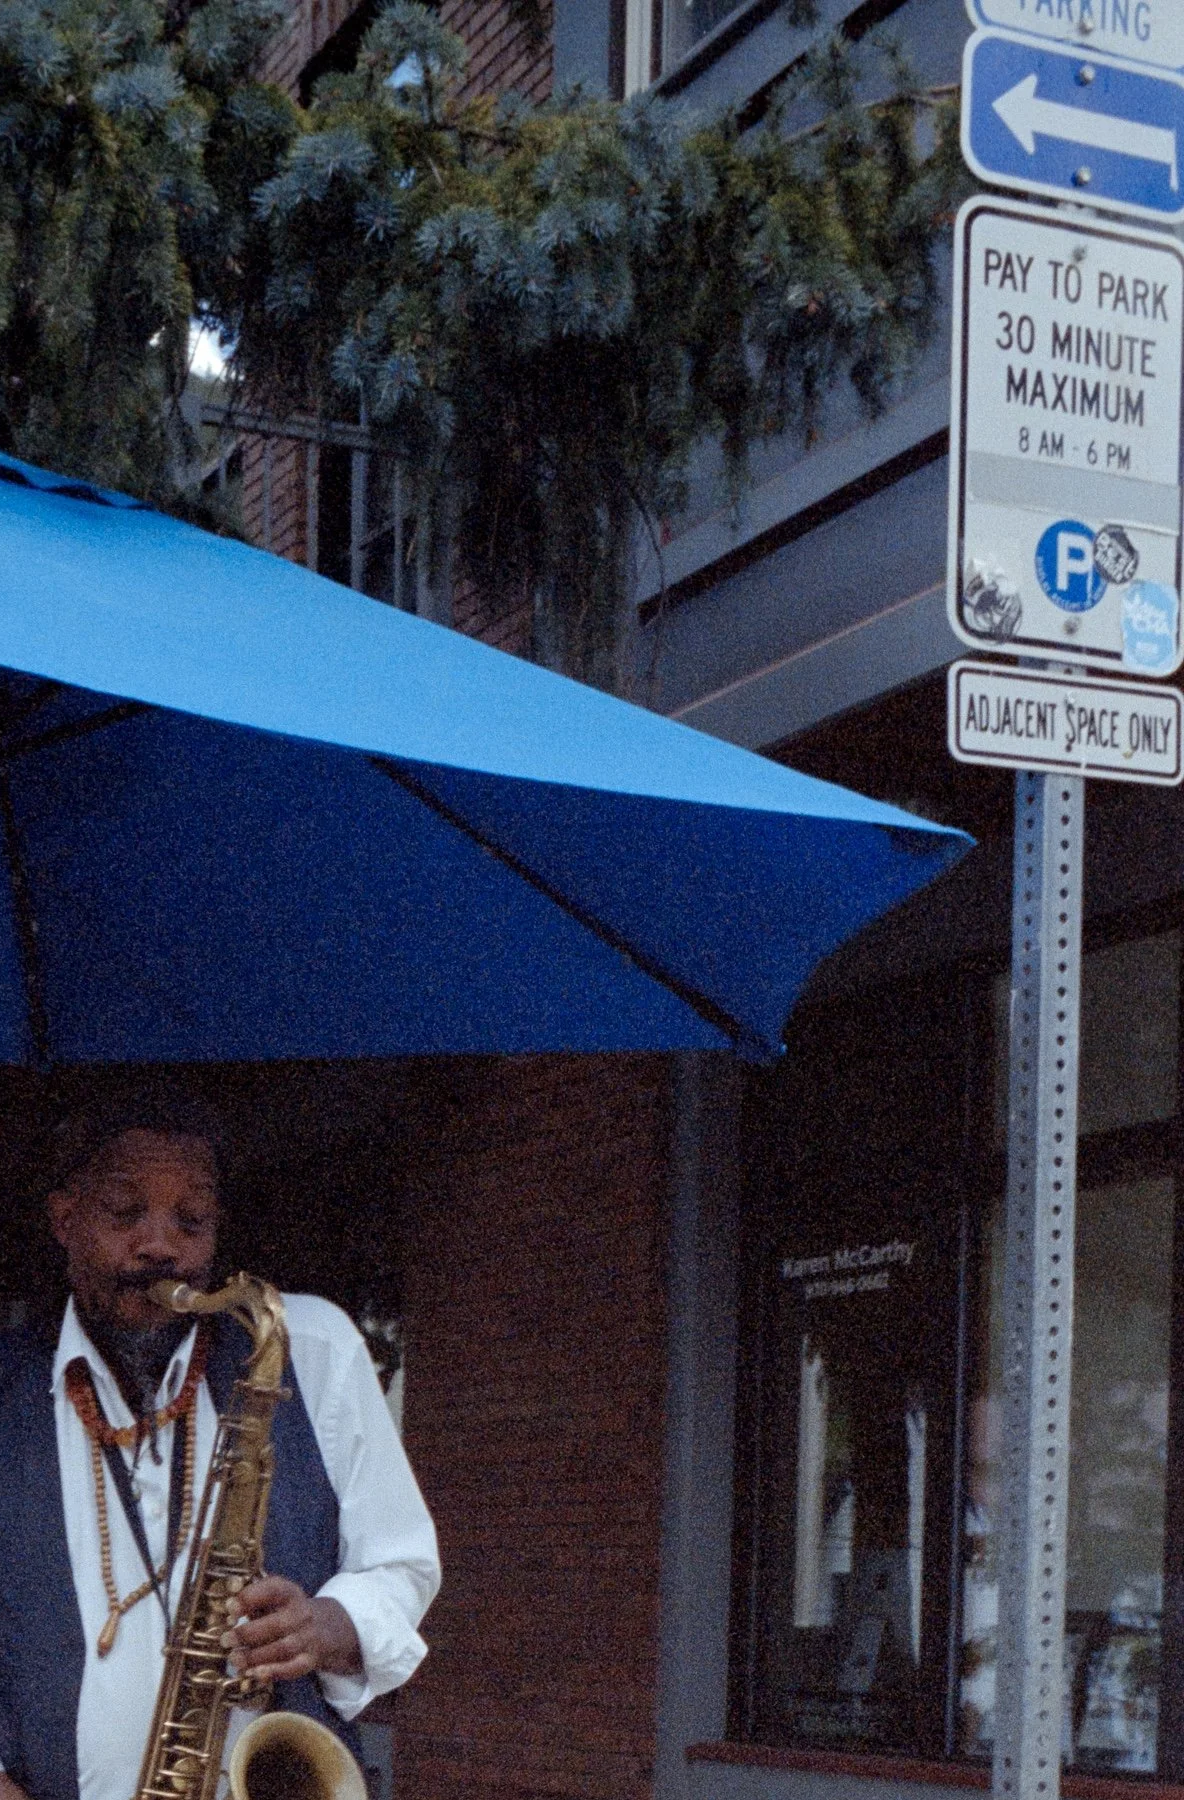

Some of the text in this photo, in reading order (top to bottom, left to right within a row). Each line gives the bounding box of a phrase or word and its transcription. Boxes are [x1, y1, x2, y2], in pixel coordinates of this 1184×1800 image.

[984, 248, 1168, 322] PAY TO PARK
[996, 311, 1156, 378] 30 MINUTE
[1006, 364, 1145, 427] MAXIMUM
[1019, 426, 1030, 453] 8
[1038, 430, 1065, 459] AM
[1087, 440, 1099, 466] 6
[1107, 442, 1131, 471] PM
[966, 693, 1173, 756] ADJACENT SPACE ONLY
[834, 1239, 915, 1271] McCarthy
